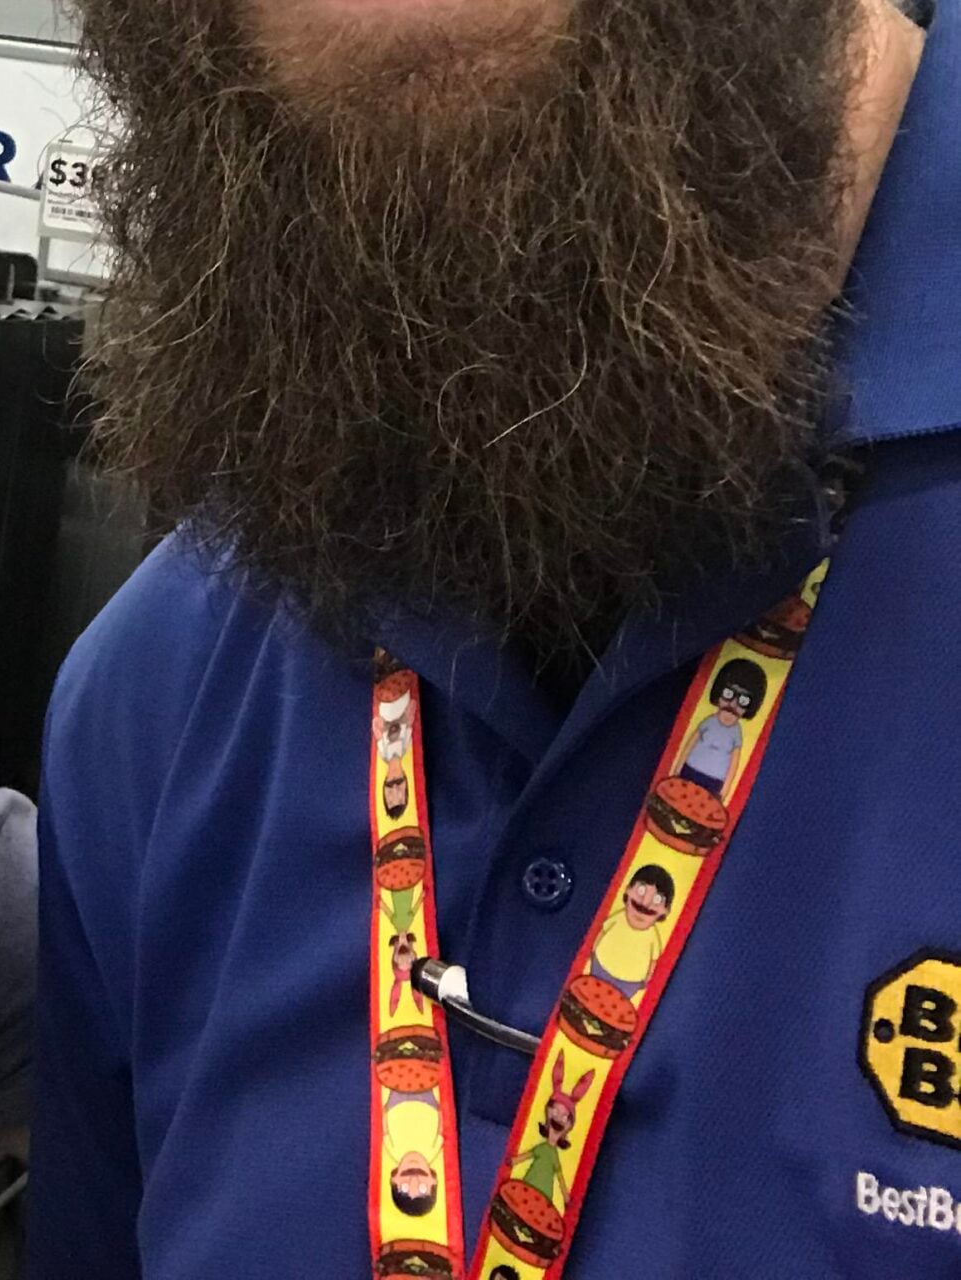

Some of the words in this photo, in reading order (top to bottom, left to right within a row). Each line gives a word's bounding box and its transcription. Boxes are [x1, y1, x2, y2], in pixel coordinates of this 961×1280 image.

[899, 984, 961, 1053] B
[898, 1047, 961, 1109] B
[856, 1171, 961, 1235] BestB
